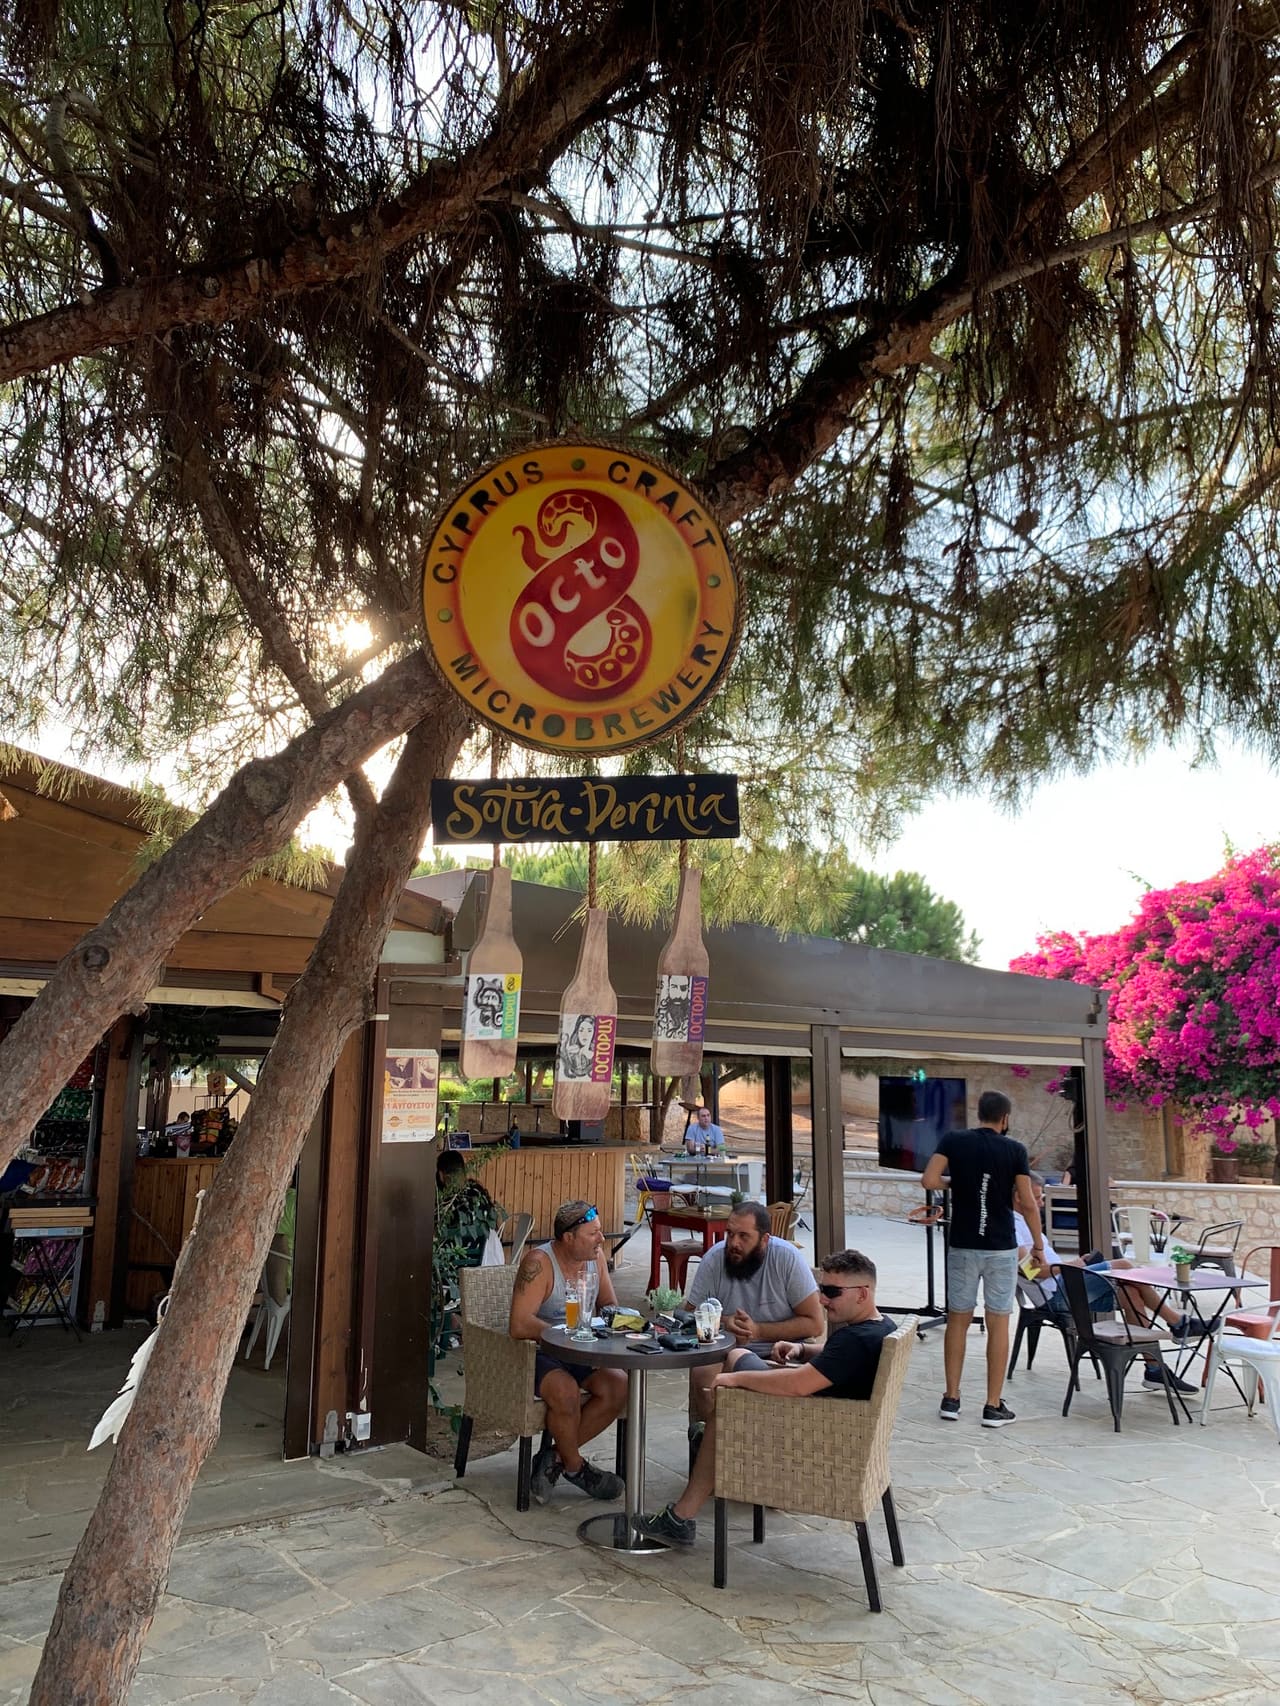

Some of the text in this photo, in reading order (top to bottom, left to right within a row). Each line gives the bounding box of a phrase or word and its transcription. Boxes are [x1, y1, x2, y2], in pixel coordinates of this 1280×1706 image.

[433, 460, 717, 583] CYPRUS CRAFT
[450, 619, 724, 741] MICROBREWERY
[595, 1019, 613, 1074] OCTOPUS
[690, 981, 706, 1034] OCTOPUS
